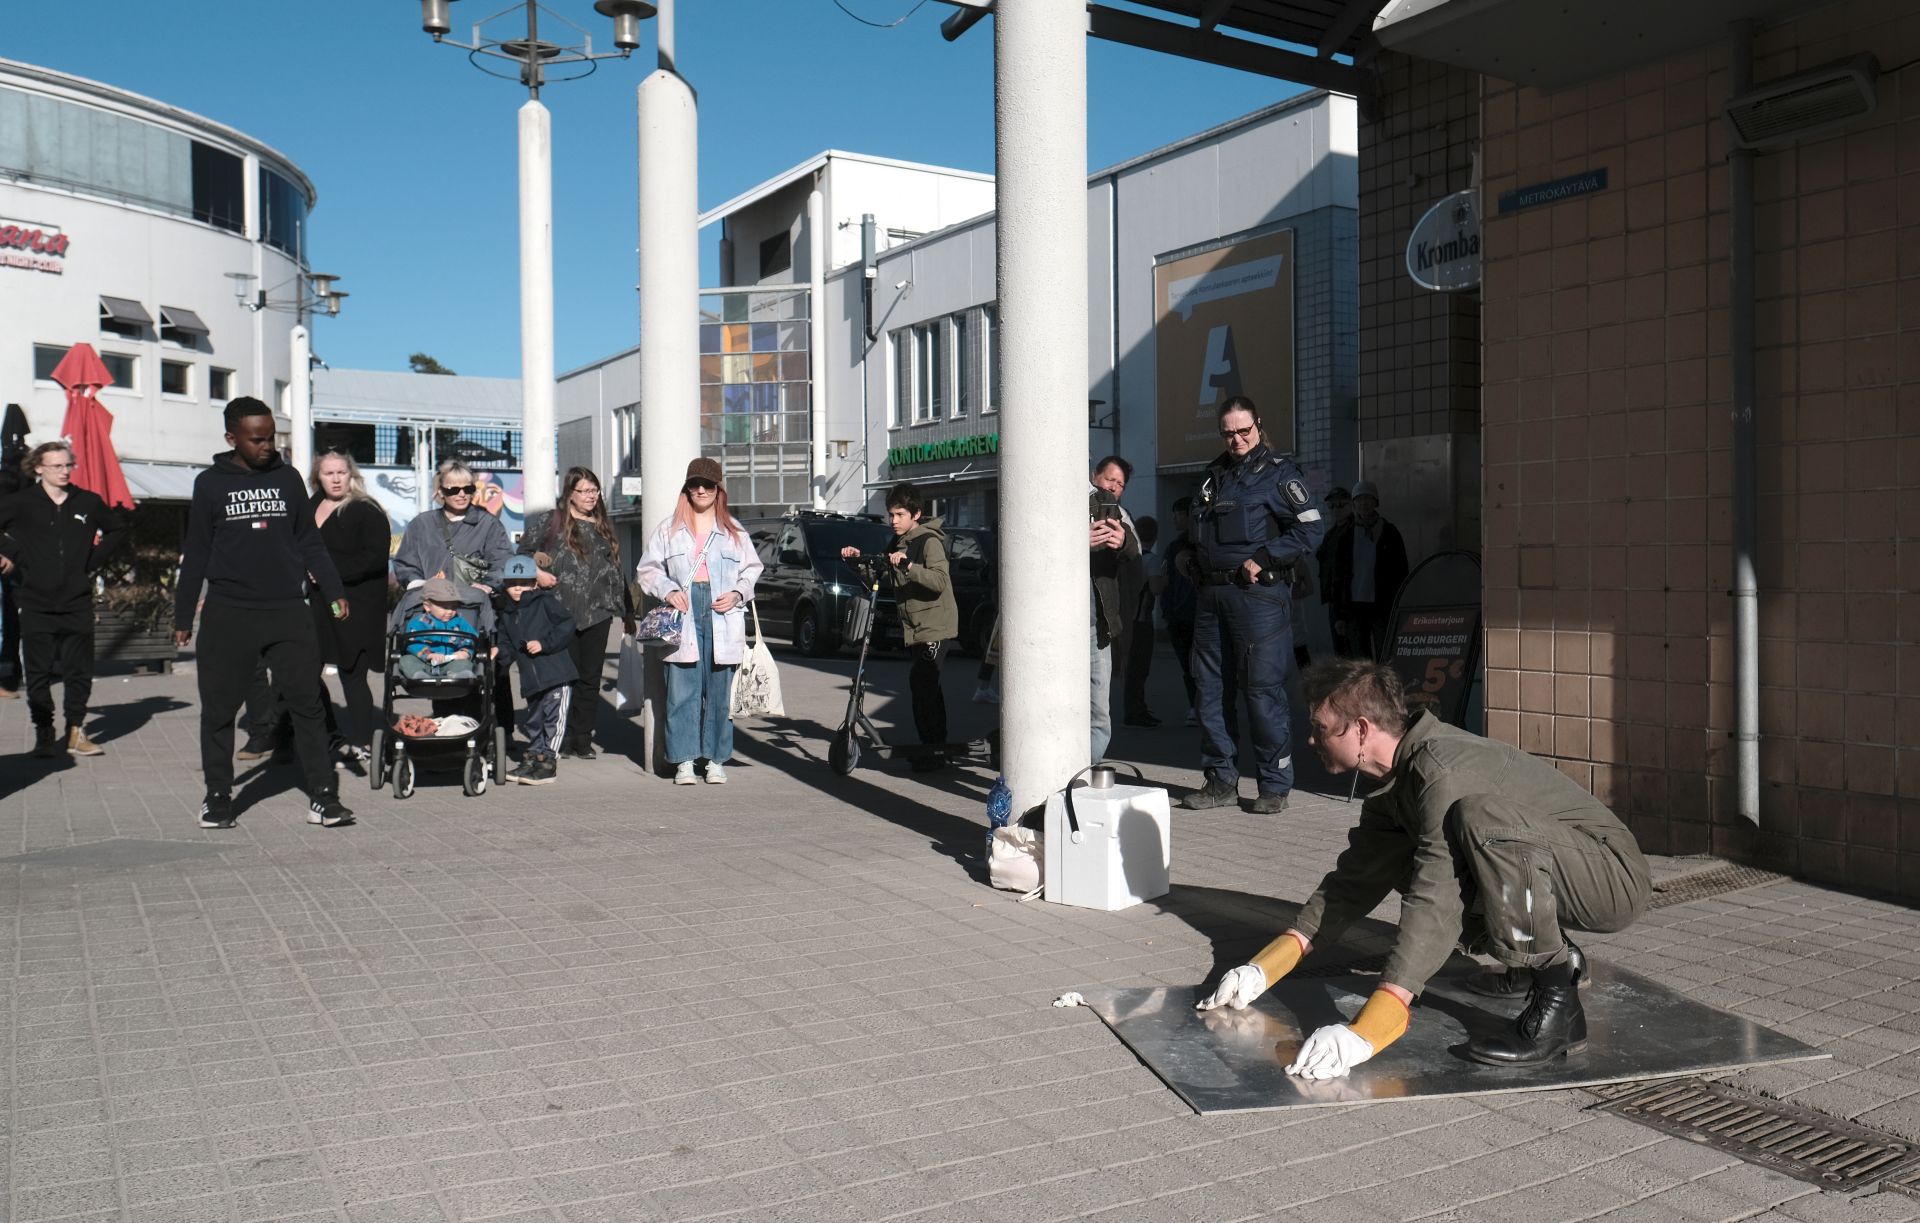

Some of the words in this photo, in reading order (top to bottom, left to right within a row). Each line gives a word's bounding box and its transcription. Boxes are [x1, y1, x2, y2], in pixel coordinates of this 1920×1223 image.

[1519, 176, 1599, 206] METROKÄYTÄVÄ
[0, 224, 68, 255] ana
[1417, 229, 1480, 272] Kromba
[888, 432, 998, 466] KONTULANKAAREN
[225, 500, 288, 516] HILFIGER
[227, 488, 281, 503] TOMMY
[1397, 636, 1427, 645] TALON
[1427, 634, 1468, 644] BURGERI
